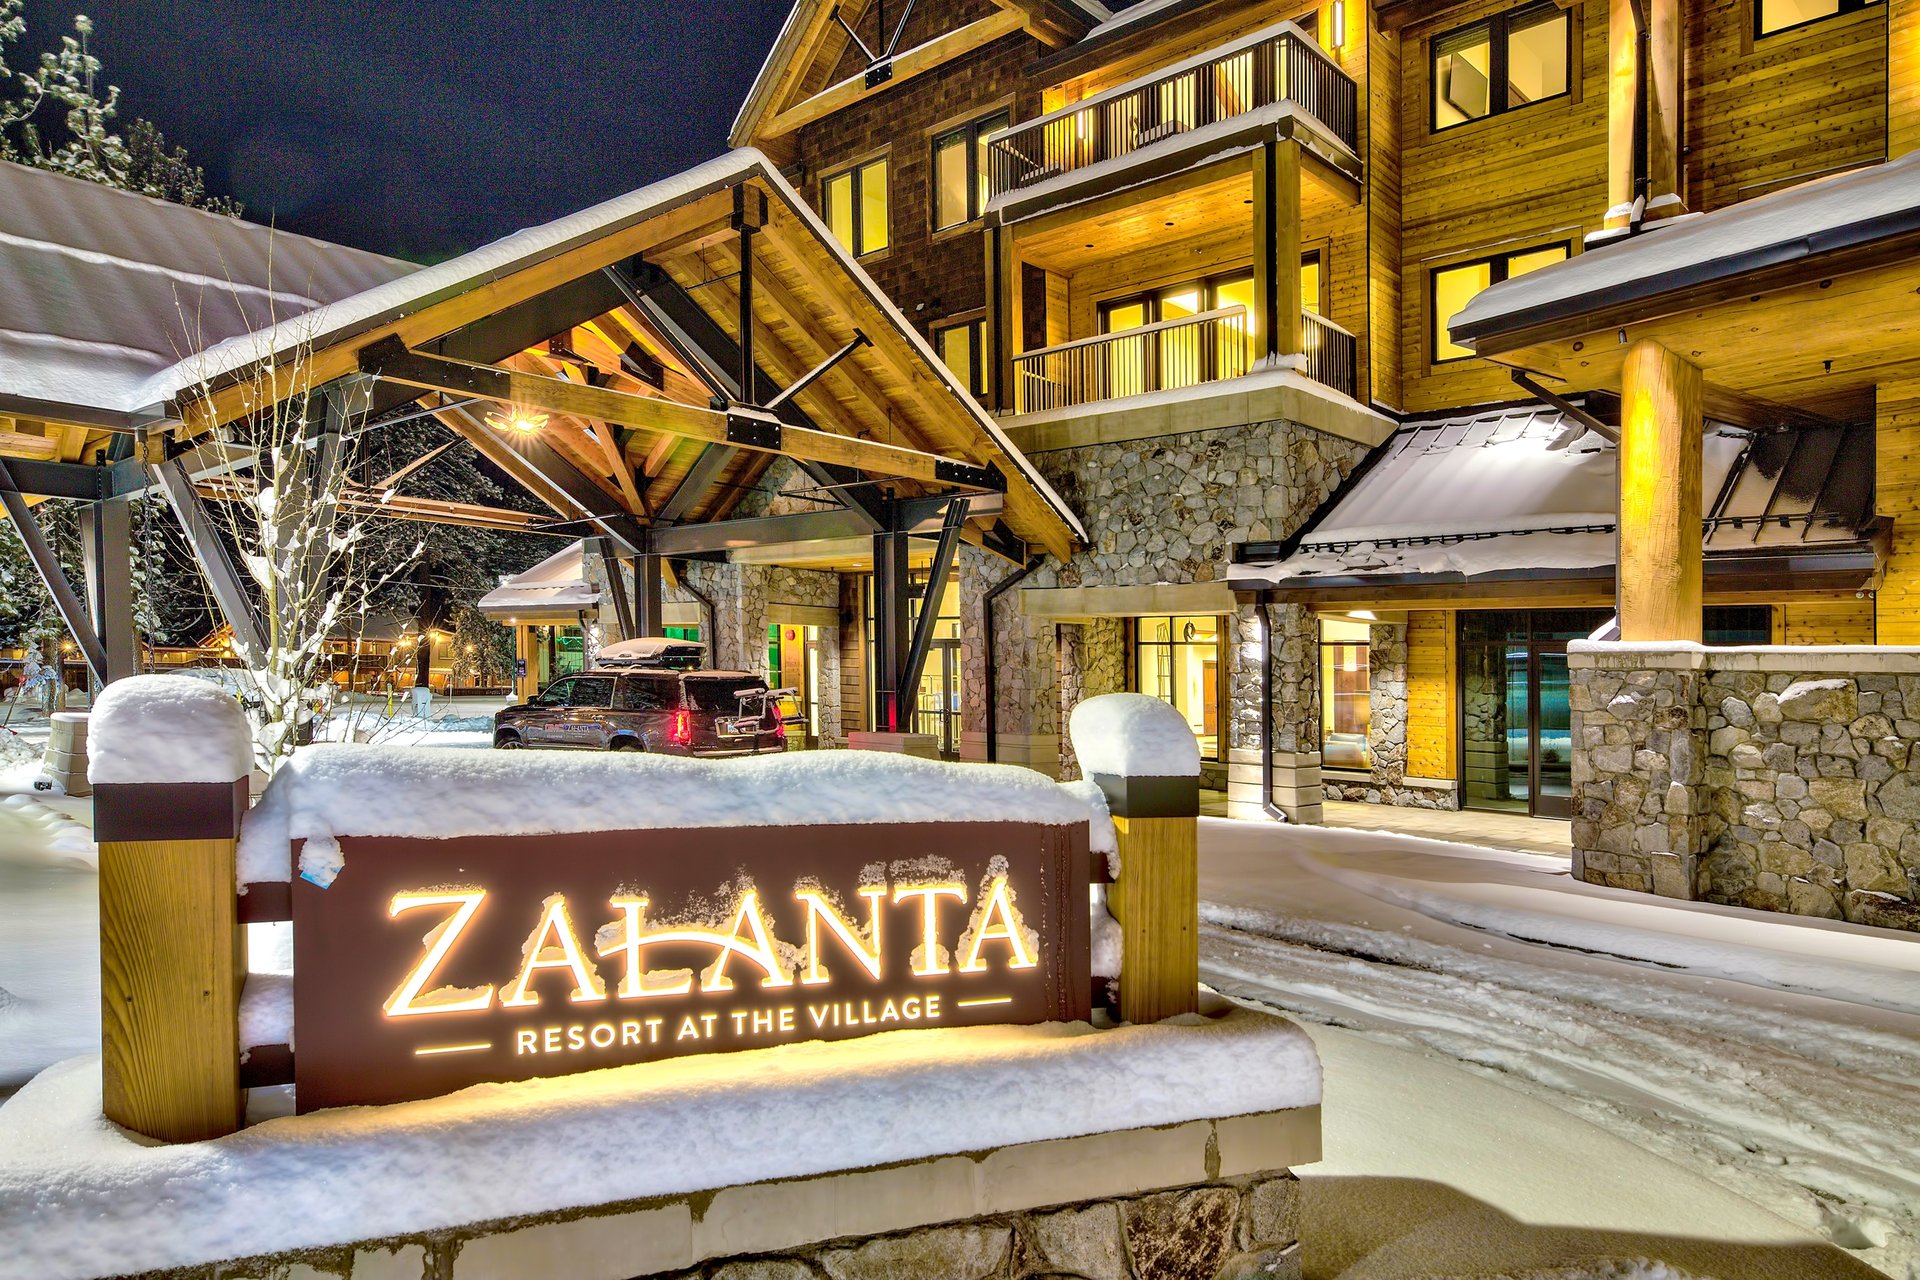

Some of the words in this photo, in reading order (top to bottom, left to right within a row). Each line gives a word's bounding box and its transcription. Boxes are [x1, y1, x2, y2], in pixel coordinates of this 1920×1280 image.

[385, 875, 1039, 1016] ZALANTA
[517, 1018, 663, 1055] RESORT
[677, 1014, 718, 1041] AT
[731, 1007, 796, 1036] THE
[808, 995, 941, 1029] VILLAGE
